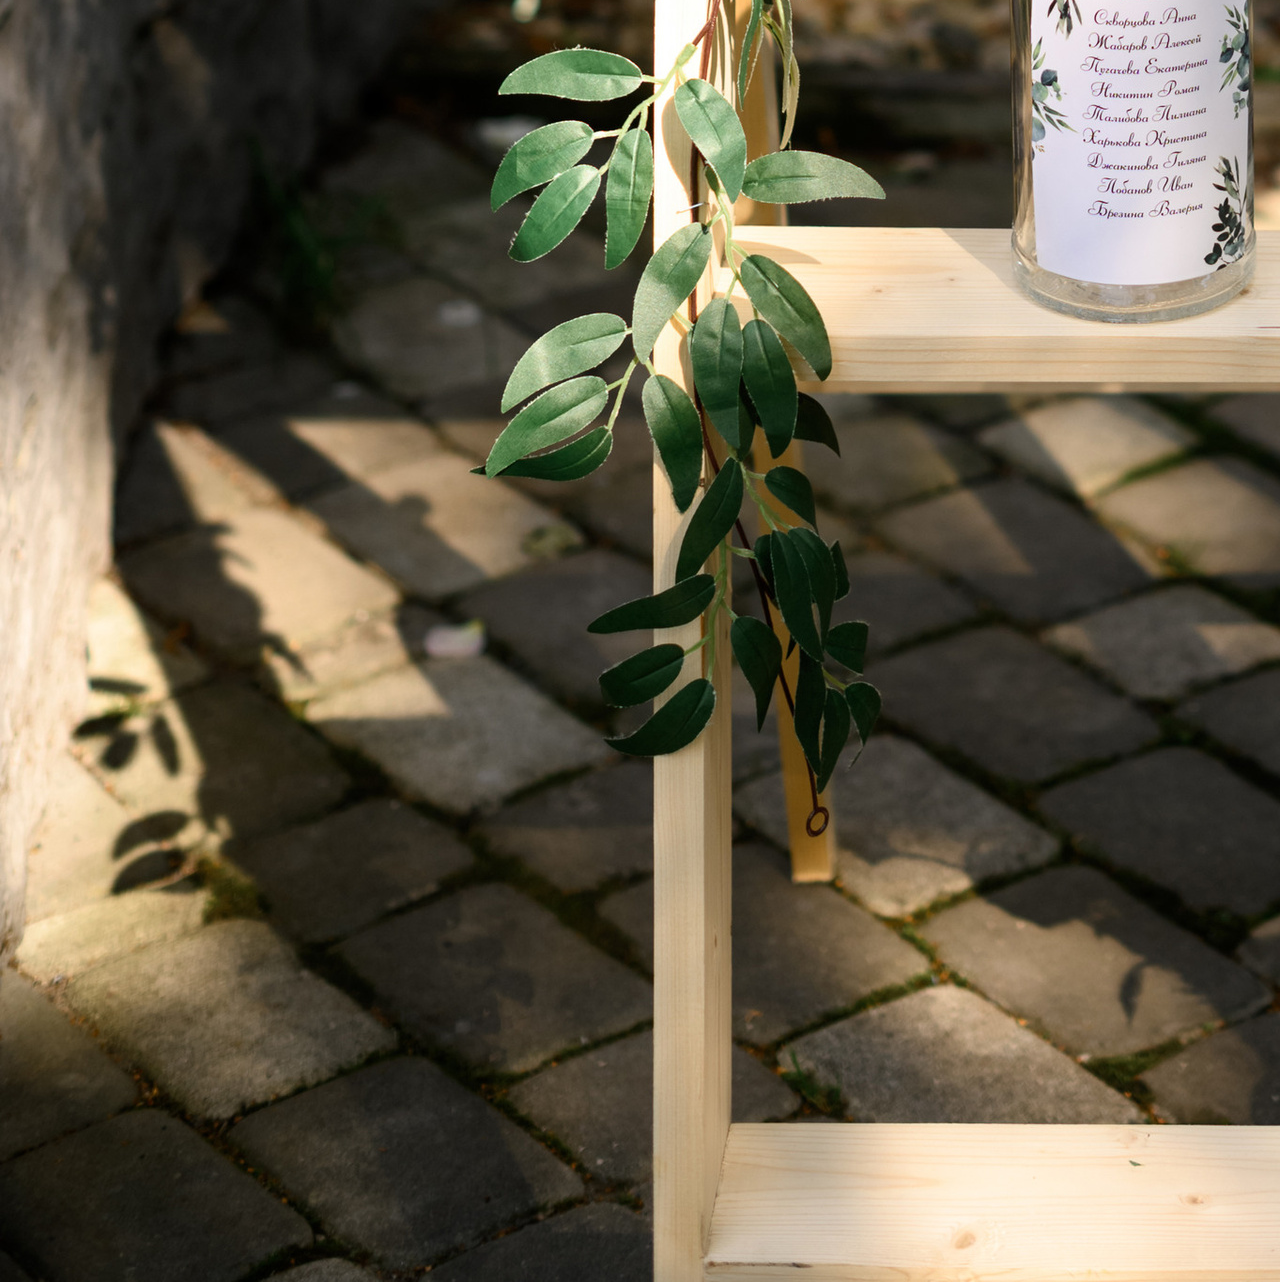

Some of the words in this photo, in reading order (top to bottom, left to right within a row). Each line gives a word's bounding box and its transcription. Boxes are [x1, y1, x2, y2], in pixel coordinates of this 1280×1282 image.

[1094, 8, 1155, 28] Скворцова
[1159, 7, 1197, 25] Анна
[1088, 32, 1147, 53] Жабаров
[1151, 33, 1202, 50] Алексей
[1080, 56, 1140, 76] Пугачева
[1144, 58, 1208, 74] Екатерина
[1091, 81, 1153, 99] Никитин
[1158, 80, 1200, 98] Роман
[1082, 104, 1149, 123] Талибова
[1152, 104, 1207, 121] Лилиана
[1083, 127, 1141, 148] Харькова
[1145, 130, 1207, 147] Кристина
[1087, 152, 1159, 171] Джакинова
[1097, 177, 1152, 195] Лобанов
[1157, 175, 1193, 192] Иван
[1088, 200, 1144, 219] Брезина
[1148, 200, 1203, 217] Валерия
